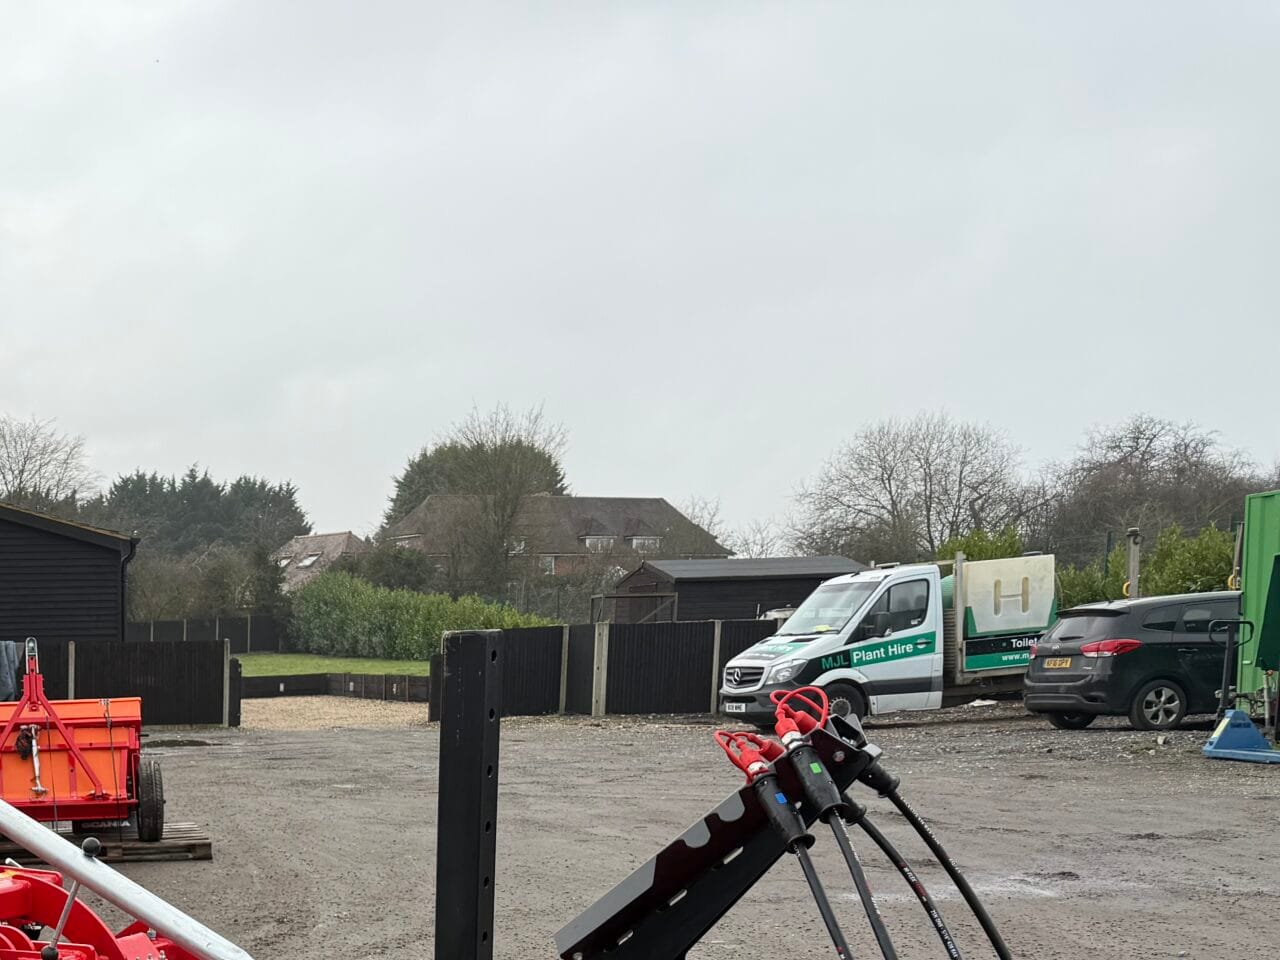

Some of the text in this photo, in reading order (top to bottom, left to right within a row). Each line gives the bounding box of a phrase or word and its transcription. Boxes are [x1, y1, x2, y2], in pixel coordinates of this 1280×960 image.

[821, 655, 849, 670] MJL
[852, 643, 914, 664] Plant Hire
